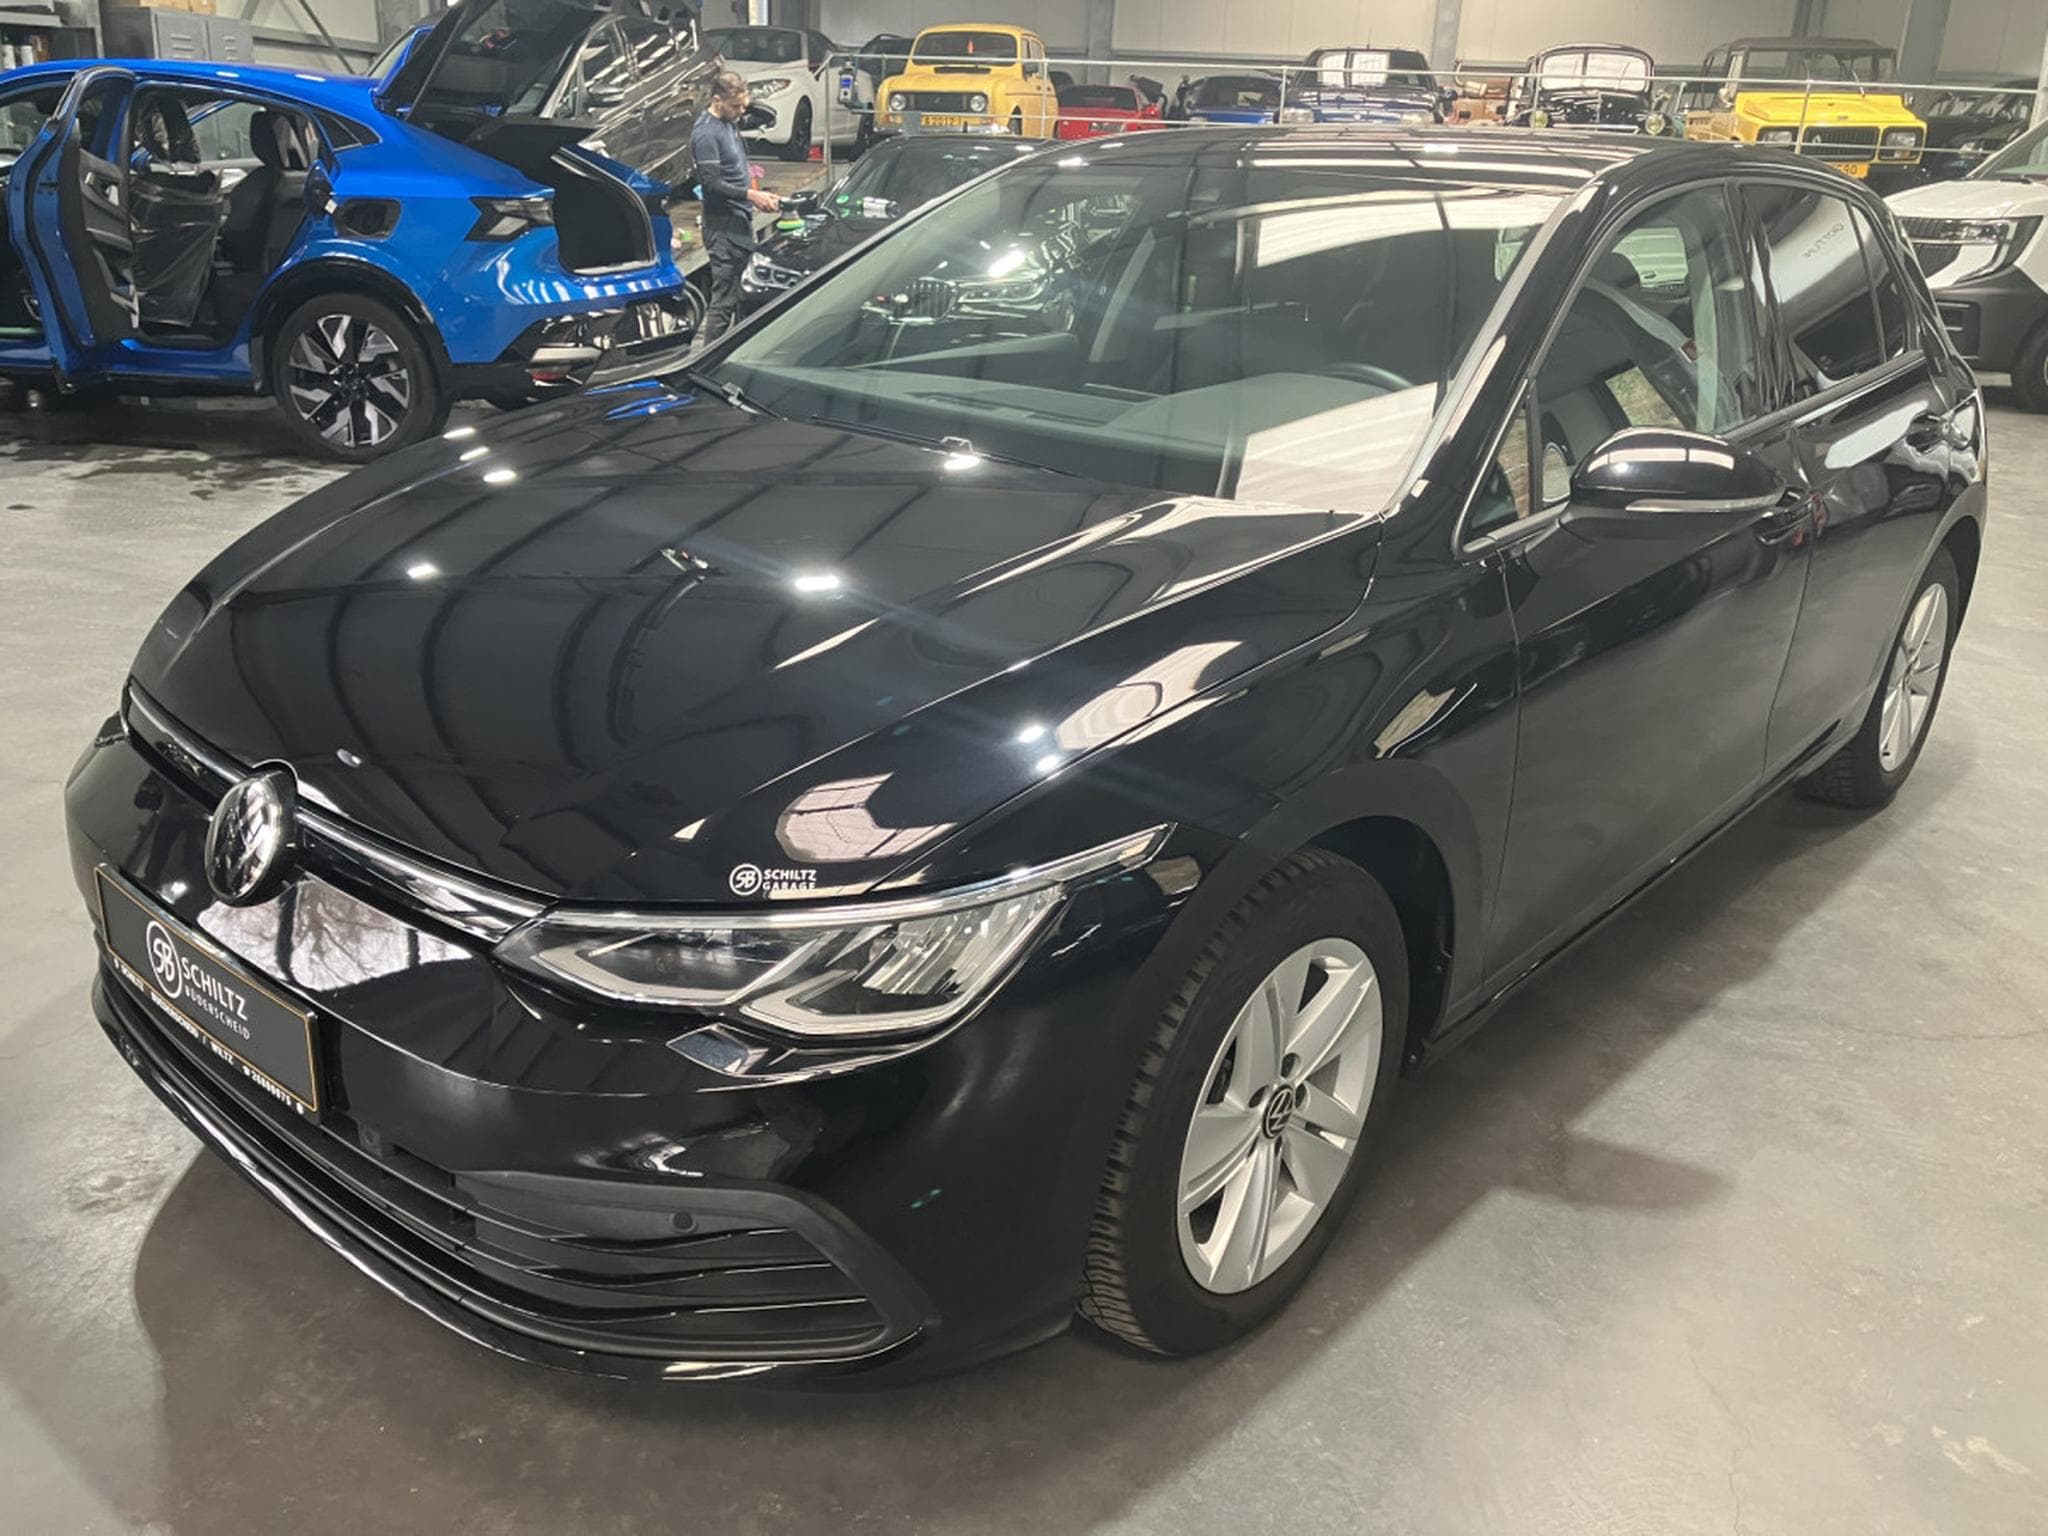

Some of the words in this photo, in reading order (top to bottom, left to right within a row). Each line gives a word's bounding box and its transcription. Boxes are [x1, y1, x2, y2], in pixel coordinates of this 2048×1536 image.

[763, 869, 817, 881] SCHILTZ
[762, 881, 816, 890] GARAGE
[181, 957, 248, 1021] SCHILTZ
